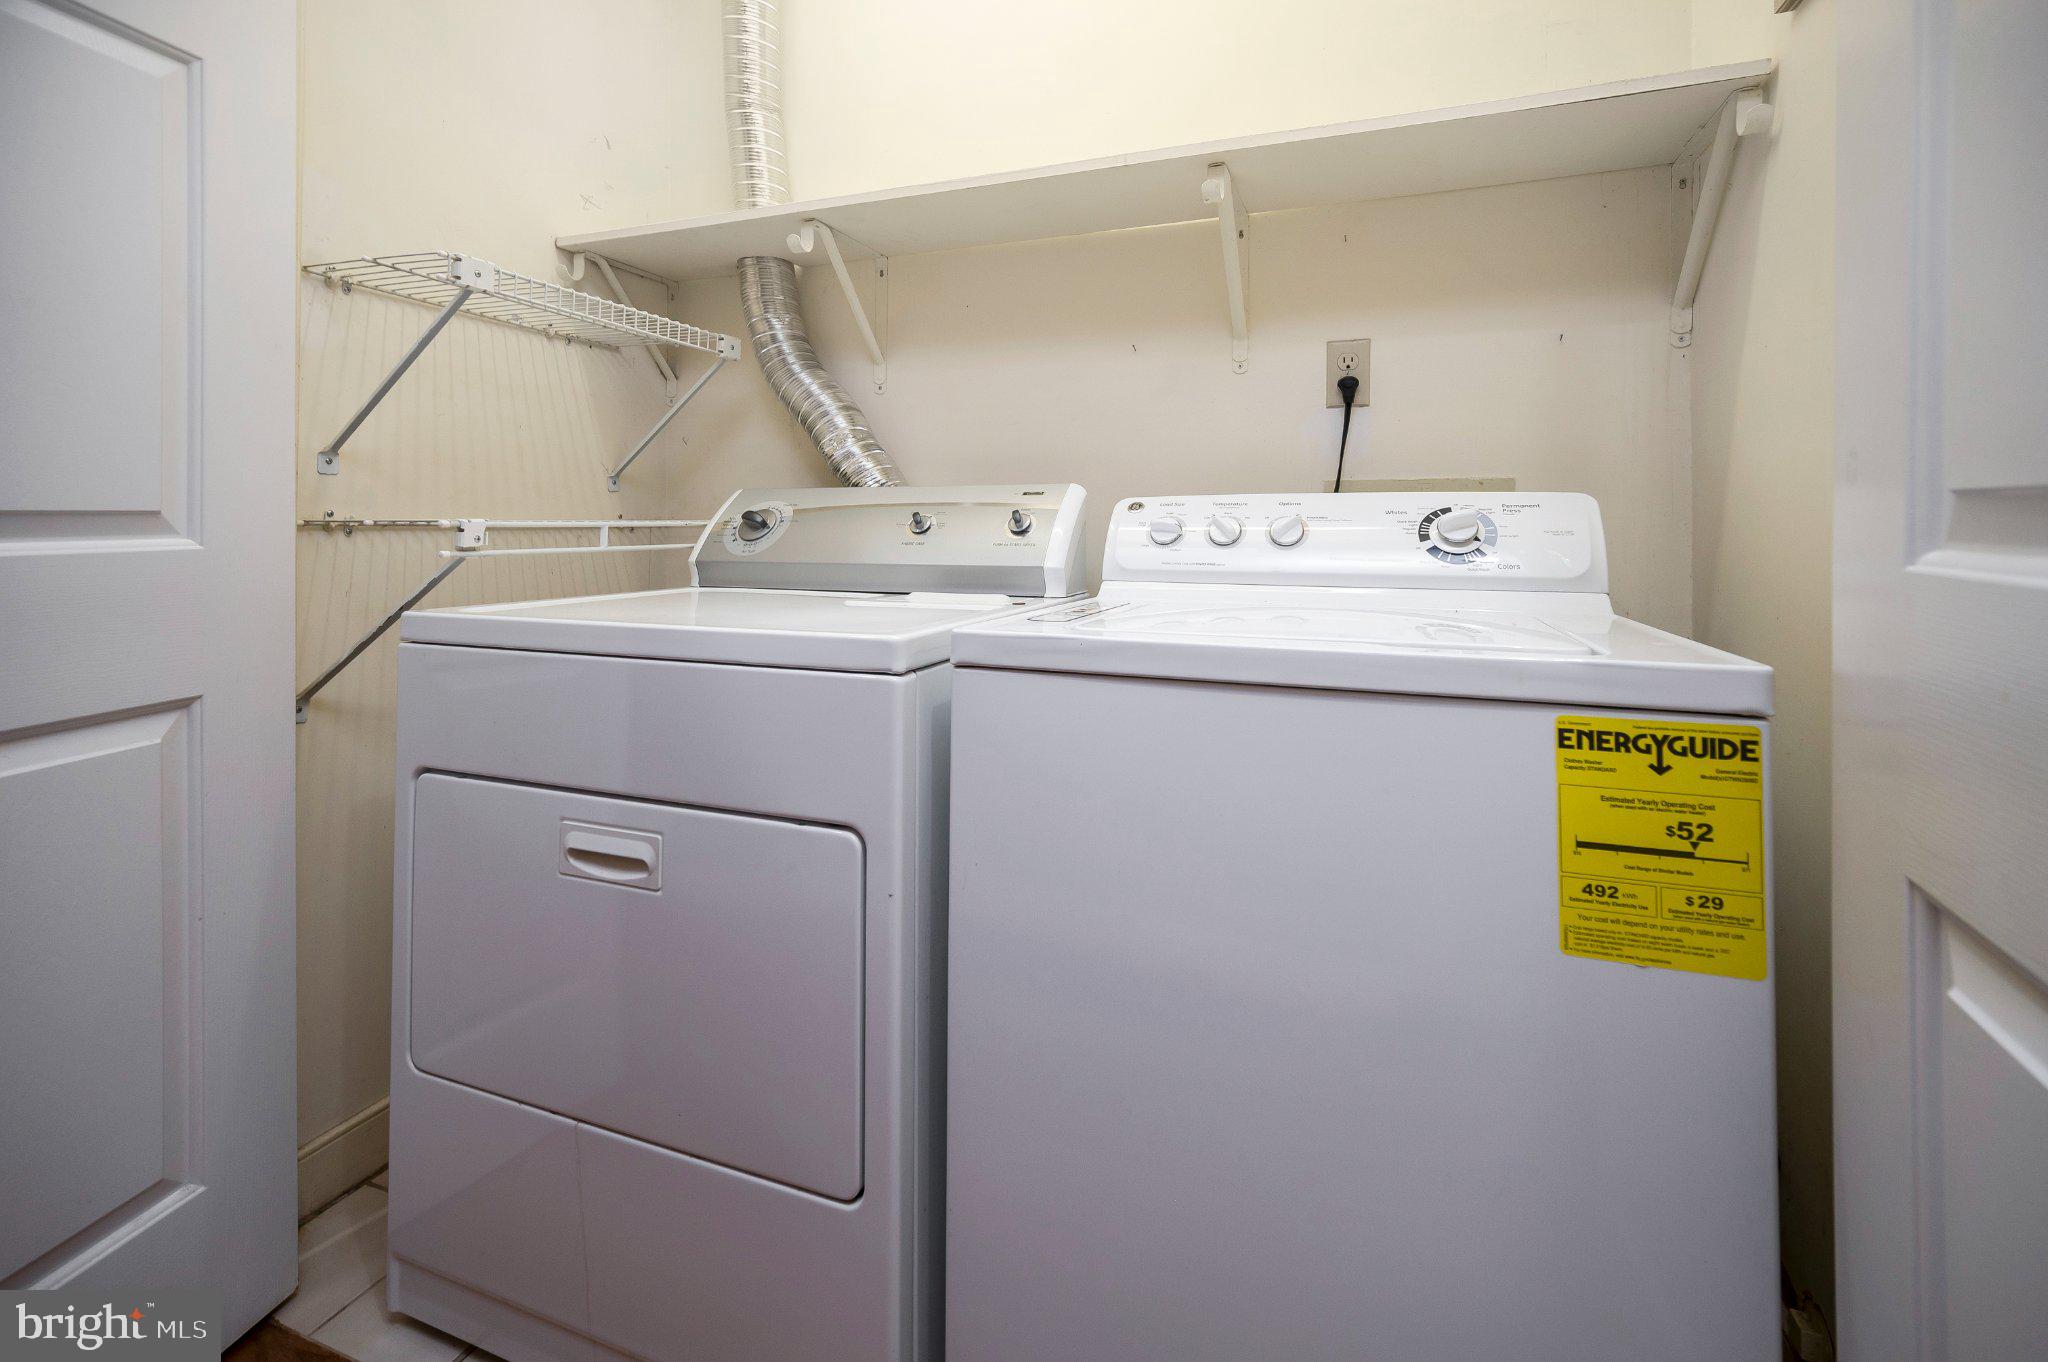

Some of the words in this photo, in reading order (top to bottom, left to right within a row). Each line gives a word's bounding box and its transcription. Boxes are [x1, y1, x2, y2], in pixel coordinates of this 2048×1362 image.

[1557, 728, 1760, 763] ENERGYGUIDE
[1600, 795, 1636, 805] Estimated
[1637, 798, 1660, 807] Yearly
[1661, 801, 1697, 811] Operating
[1698, 803, 1716, 811] Cost
[1665, 820, 1715, 843] $52
[1581, 883, 1620, 900] 492
[1577, 913, 1594, 922] Your
[1594, 916, 1609, 924] cost
[1622, 920, 1648, 929] depend
[1660, 924, 1675, 932] your
[1676, 926, 1695, 936] utility
[1696, 929, 1715, 937] rates
[1715, 931, 1730, 939] and
